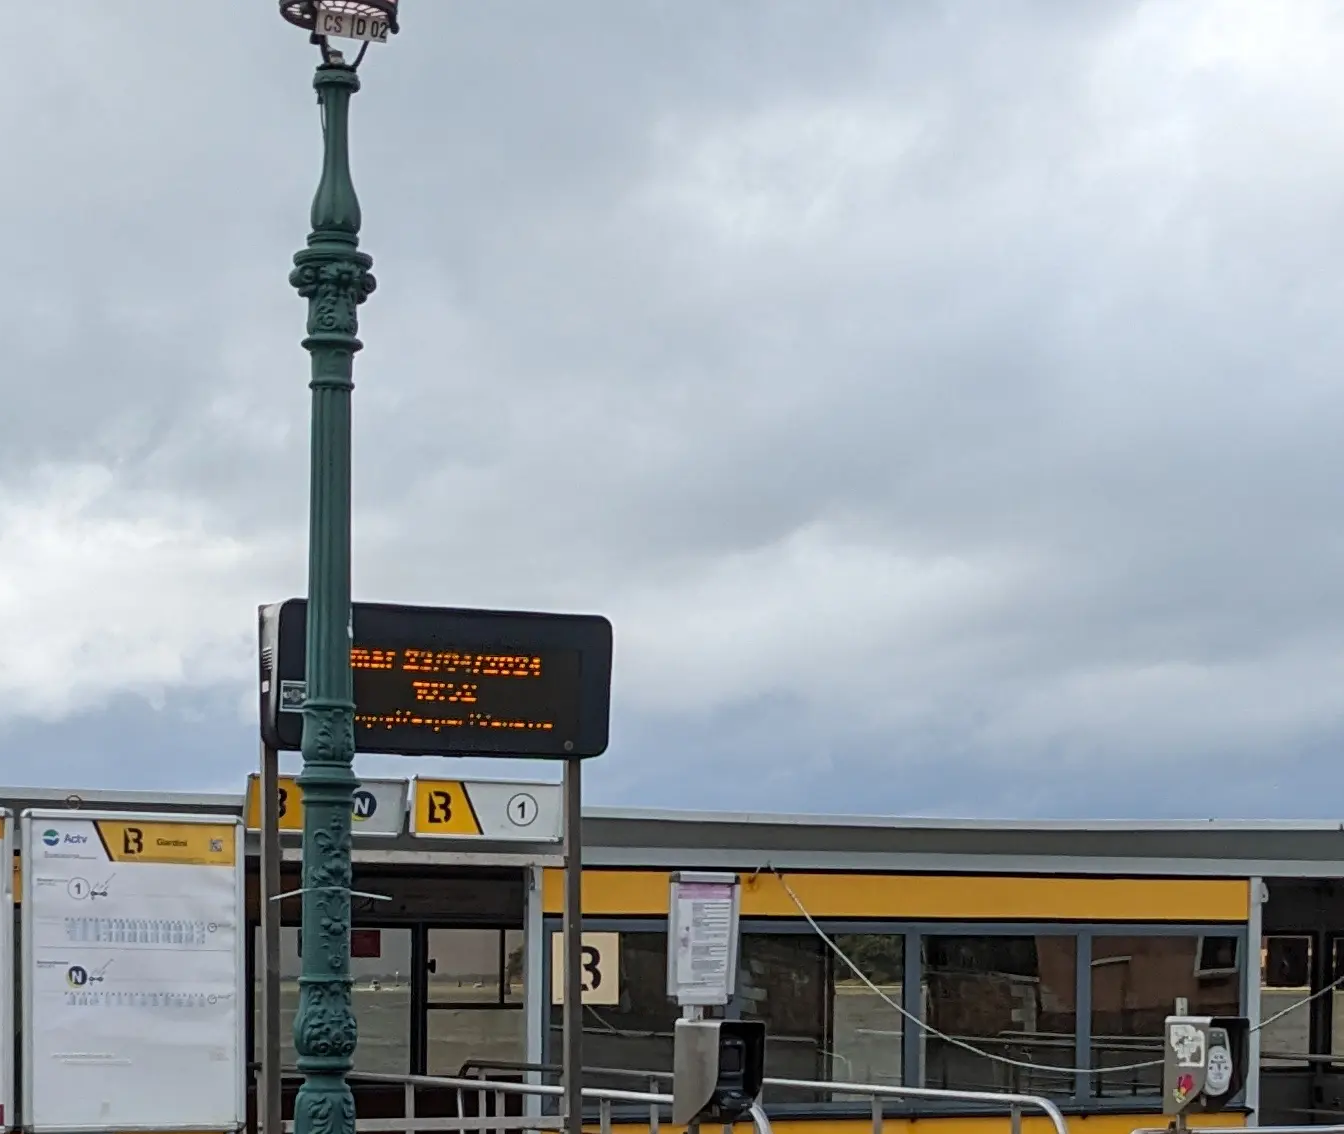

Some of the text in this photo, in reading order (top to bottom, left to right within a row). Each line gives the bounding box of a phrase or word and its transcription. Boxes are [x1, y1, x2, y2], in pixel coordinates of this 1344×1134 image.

[324, 14, 343, 33] CS
[354, 798, 370, 815] N
[428, 791, 526, 823] B 1
[64, 833, 88, 844] Actv
[123, 828, 144, 855] B
